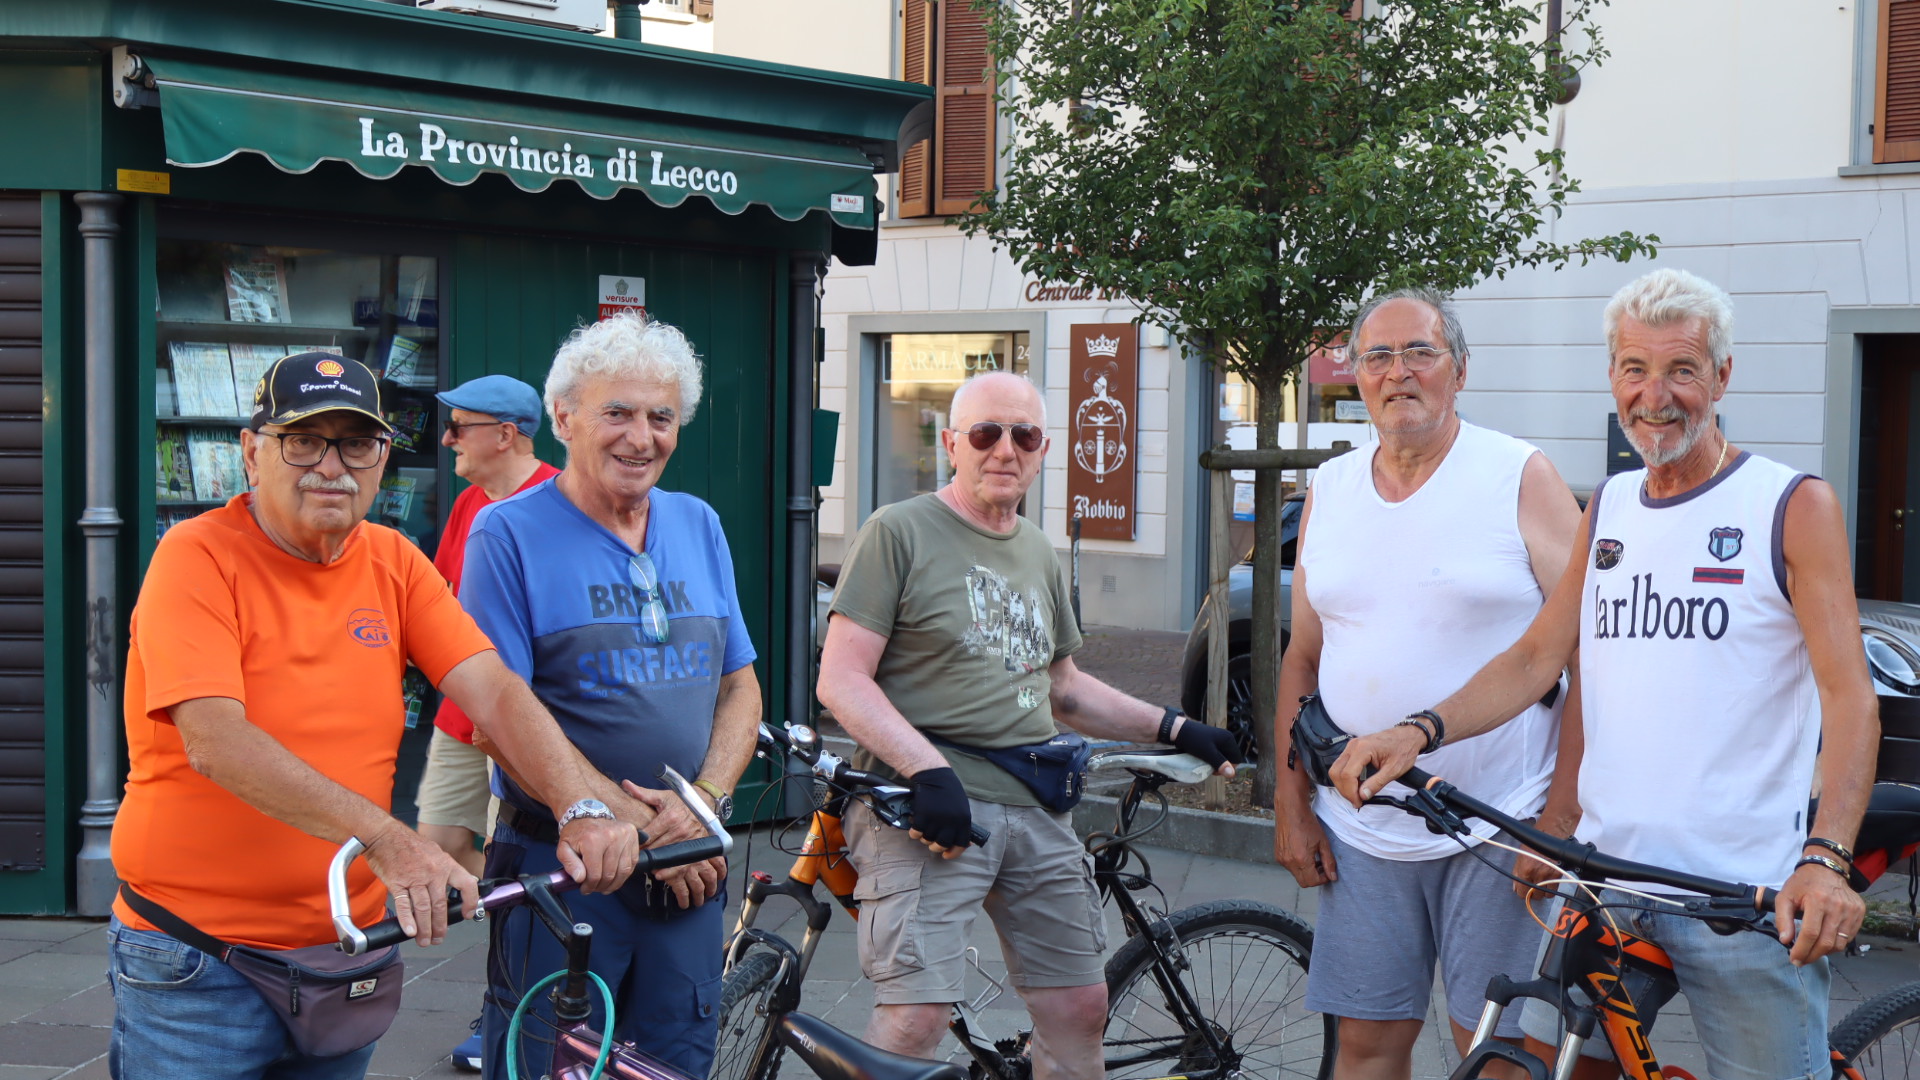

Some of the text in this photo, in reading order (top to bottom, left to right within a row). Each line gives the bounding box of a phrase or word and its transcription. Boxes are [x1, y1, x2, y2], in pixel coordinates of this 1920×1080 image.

[359, 118, 737, 195] La Provincia di Lecco
[606, 295, 638, 303] verisure
[891, 350, 998, 371] FARMACIA
[1073, 495, 1126, 520] Robbio
[1595, 572, 1730, 641] arlboro
[577, 641, 712, 690] SURFACE
